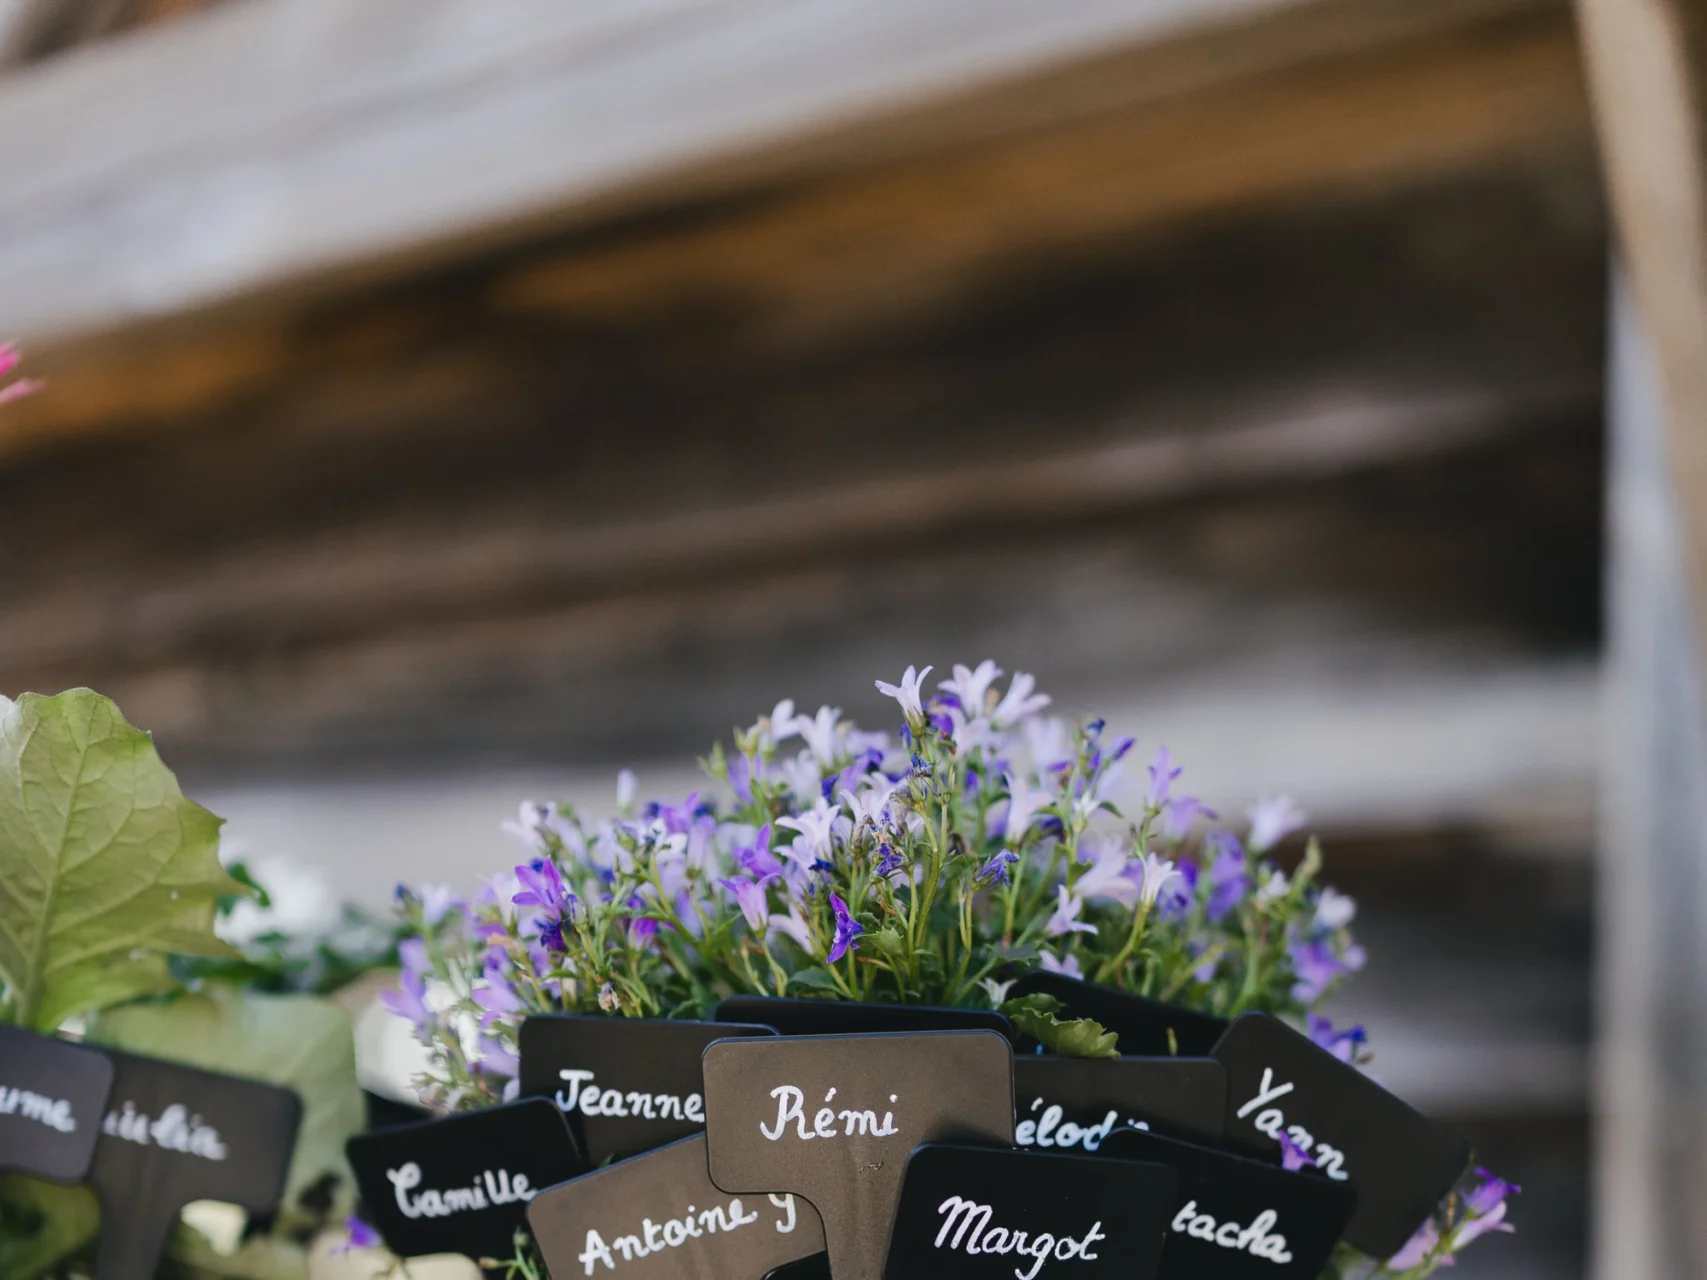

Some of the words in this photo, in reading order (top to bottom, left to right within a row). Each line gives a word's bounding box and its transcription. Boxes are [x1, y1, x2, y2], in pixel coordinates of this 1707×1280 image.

[555, 1068, 705, 1122] Jeanne
[760, 1085, 899, 1141] Rémi
[1015, 1097, 1149, 1151] élod
[1236, 1067, 1348, 1181] Yann
[386, 1162, 538, 1219] Camille
[578, 1198, 758, 1276] Antoine
[1171, 1200, 1293, 1264] tacha
